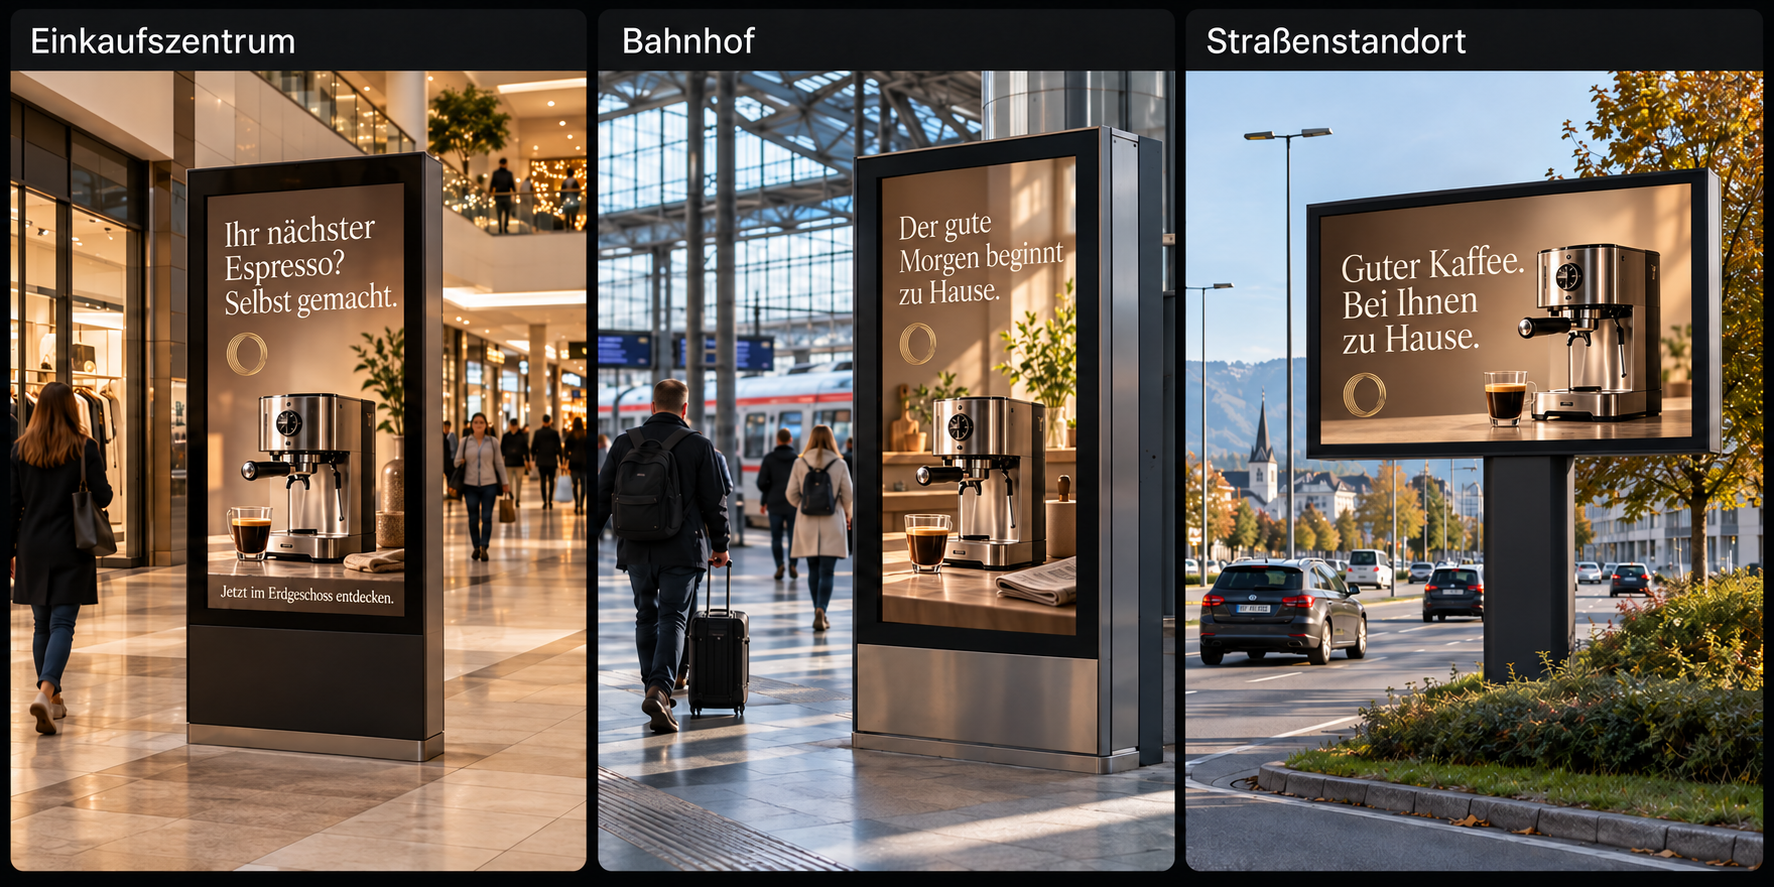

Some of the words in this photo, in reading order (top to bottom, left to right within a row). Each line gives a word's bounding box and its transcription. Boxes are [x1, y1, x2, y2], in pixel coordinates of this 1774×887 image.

[225, 221, 259, 247] Ihr
[268, 216, 375, 244] nächster
[900, 216, 938, 240] Der
[945, 213, 991, 242] gute
[225, 249, 345, 286] Espresso?
[900, 249, 979, 276] Morgen
[985, 242, 1064, 272] beginnt
[1342, 255, 1420, 282] Guter
[1430, 245, 1524, 277] Kaffee.
[225, 288, 292, 315] Selbst
[297, 282, 397, 318] gemacht.
[899, 288, 922, 305] zu
[929, 279, 1000, 304] Hause.
[1344, 290, 1387, 319] Bei
[1398, 287, 1478, 316] Ihnen
[1343, 334, 1375, 354] zu
[1386, 324, 1479, 352] Hause.
[221, 585, 247, 598] Jetzt
[251, 586, 265, 599] im
[269, 587, 333, 603] Erdgeschoss
[336, 589, 394, 604] entdecken.
